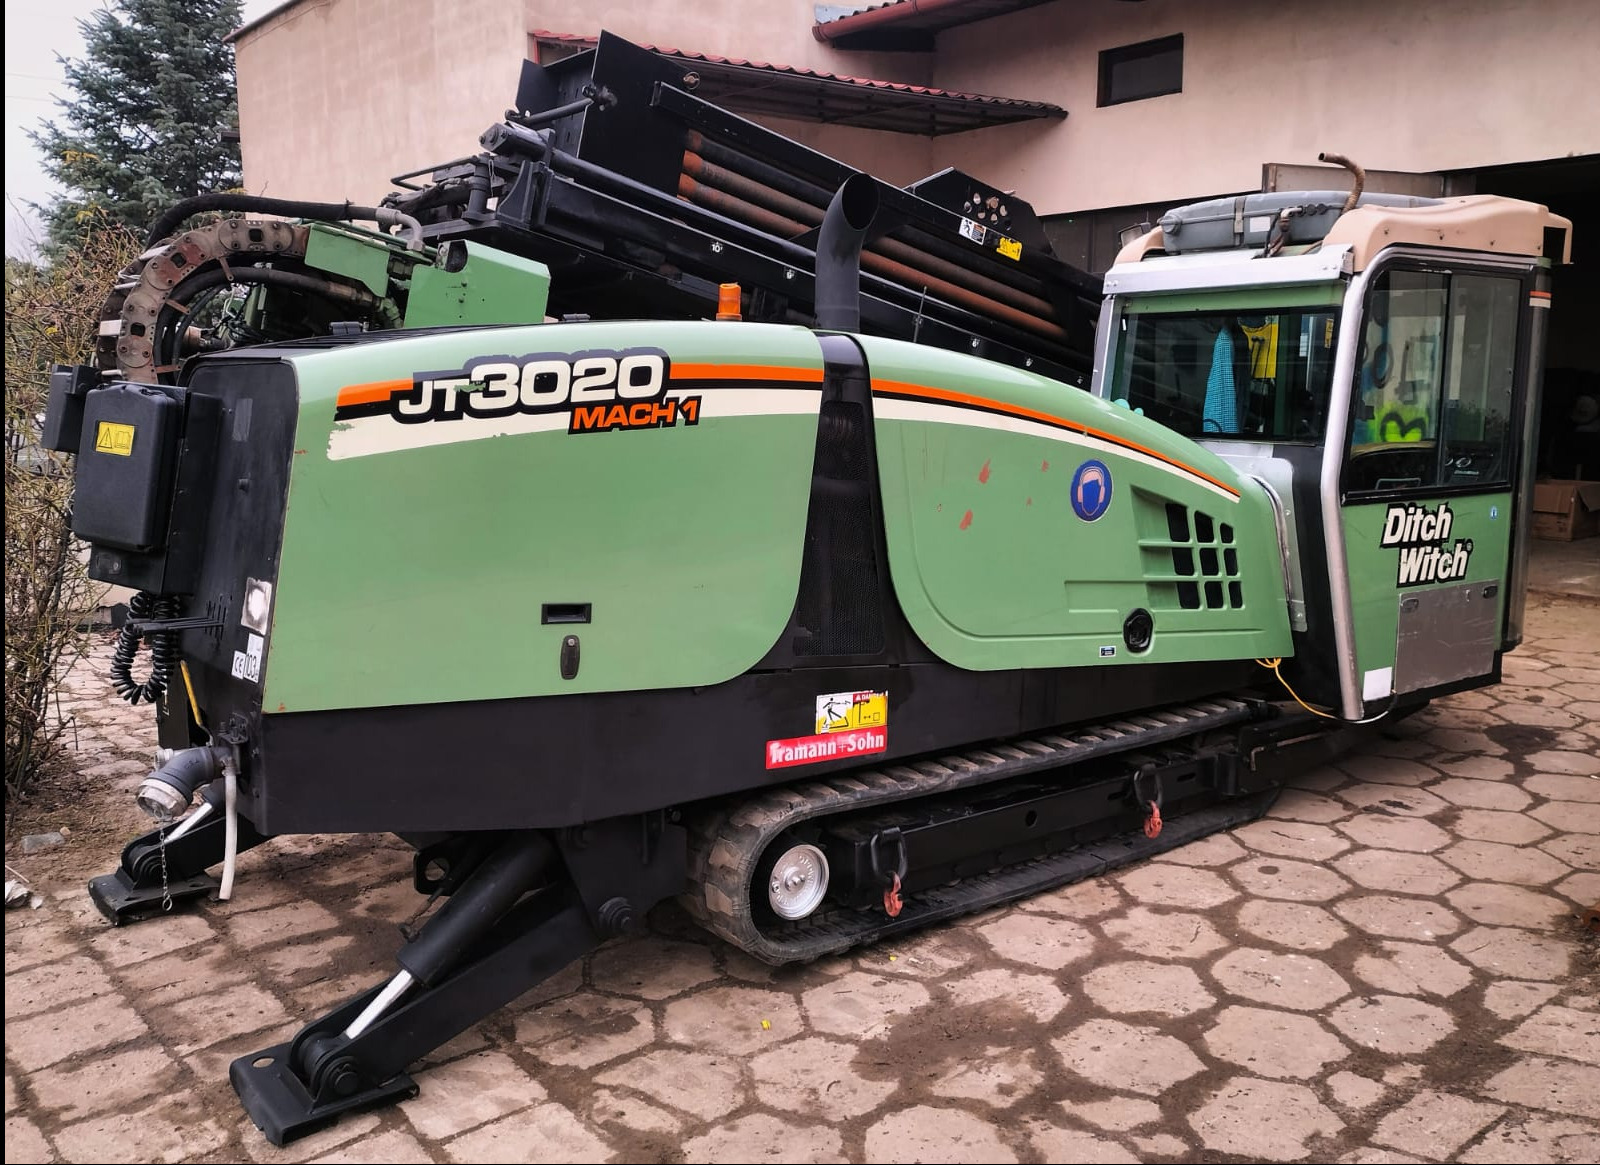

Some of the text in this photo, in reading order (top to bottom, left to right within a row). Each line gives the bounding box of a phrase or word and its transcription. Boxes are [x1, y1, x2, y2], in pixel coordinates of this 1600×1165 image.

[572, 400, 698, 430] MACH 1
[1382, 504, 1453, 545] Ditch
